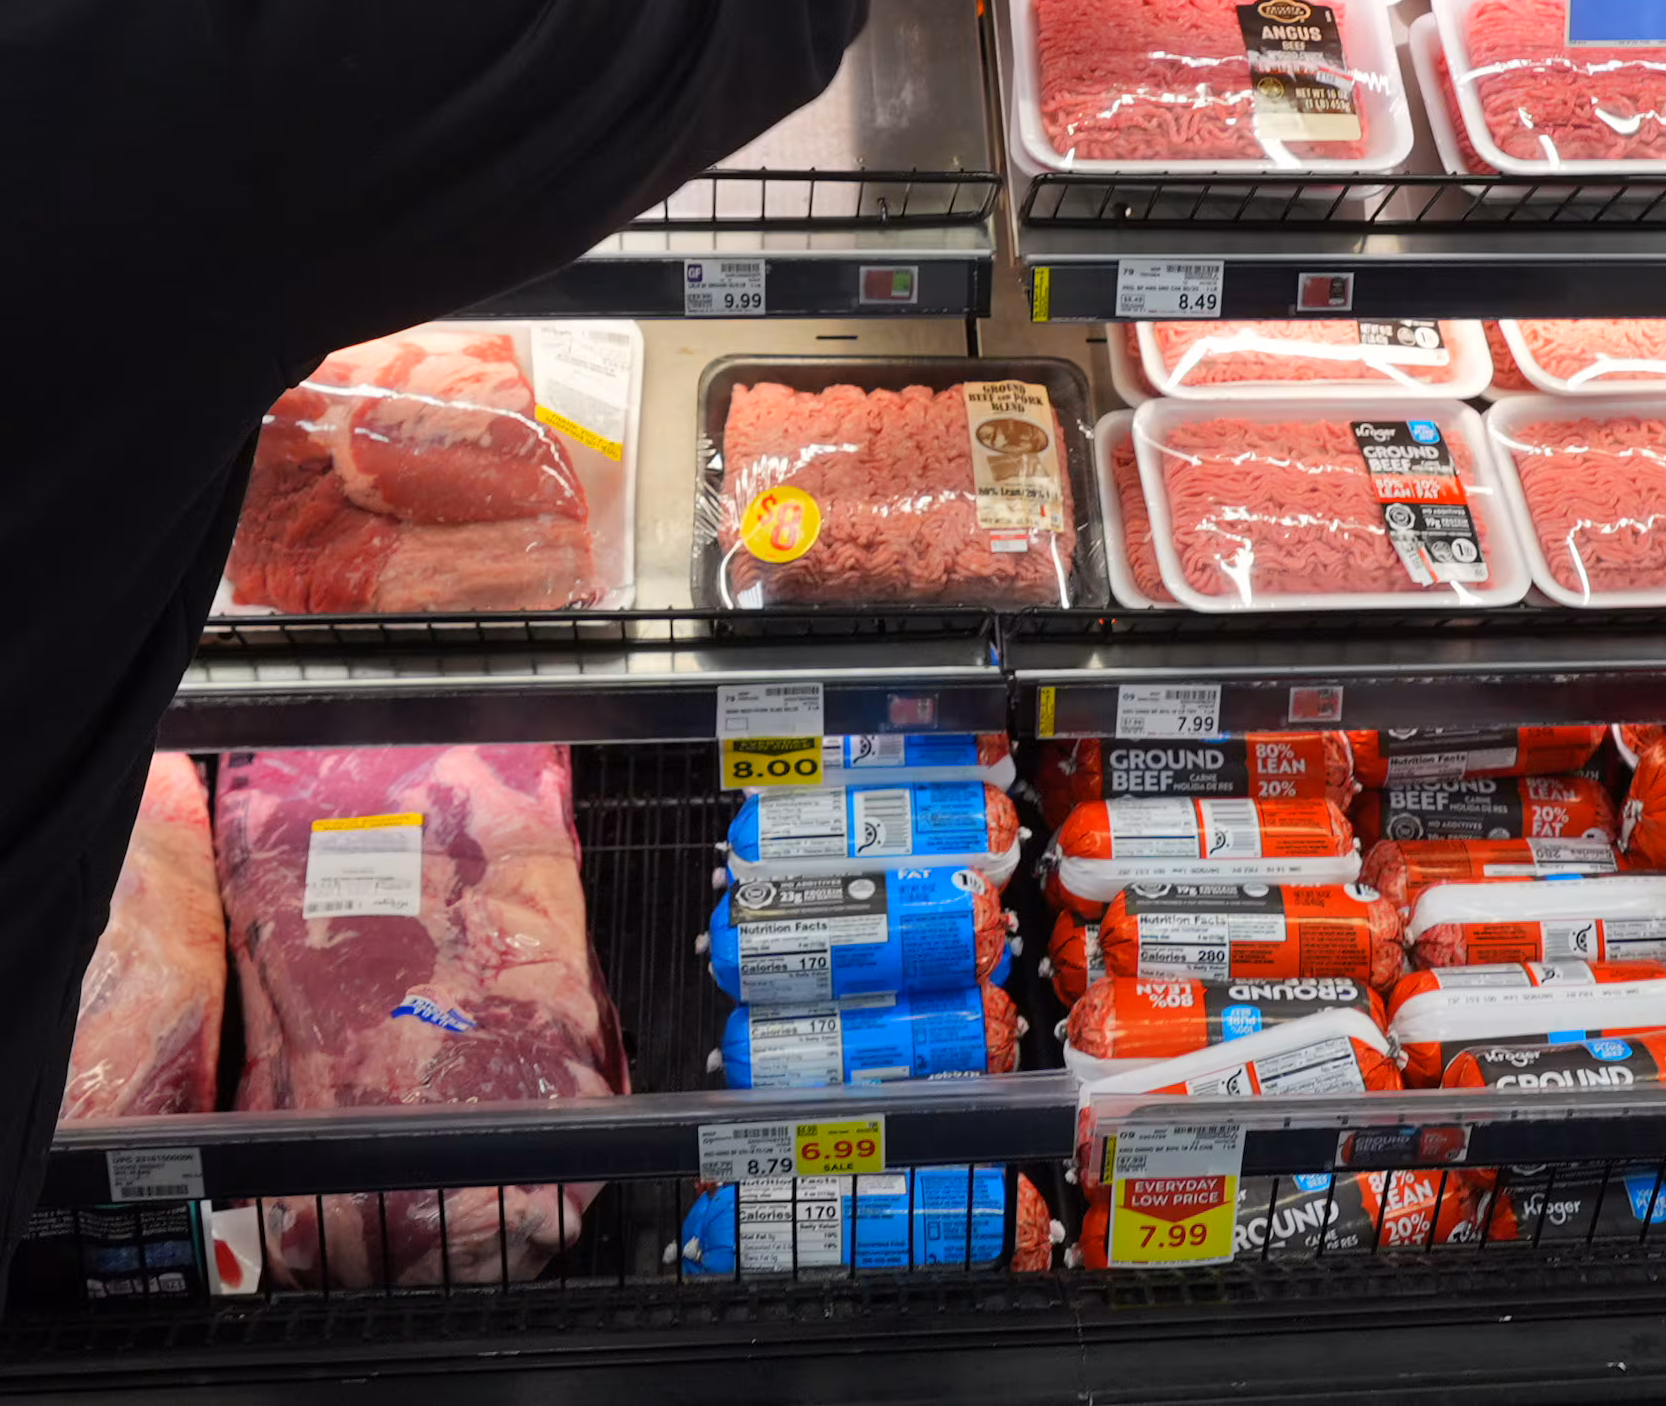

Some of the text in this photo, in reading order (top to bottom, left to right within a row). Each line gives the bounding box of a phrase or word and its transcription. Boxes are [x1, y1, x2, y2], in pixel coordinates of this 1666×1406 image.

[1260, 24, 1322, 42] ANGUS
[687, 265, 703, 279] GF
[724, 292, 762, 308] 9.99
[1178, 294, 1217, 310] 8.49
[1363, 445, 1438, 460] GROUND
[1368, 458, 1412, 473] BEEF
[1376, 486, 1439, 500] LEAN FAT
[1177, 716, 1214, 732] 7.99
[1254, 742, 1295, 759] 80%
[1109, 748, 1224, 770] GROUND
[1257, 758, 1306, 774] LEAN
[732, 758, 817, 778] 8.00
[1111, 772, 1173, 793] BEEF
[1257, 781, 1297, 797] 20%
[1389, 792, 1449, 811] BEEF
[1531, 806, 1569, 822] 20%
[1532, 821, 1561, 837] FAT
[739, 921, 827, 935] Nutrition Facts
[799, 957, 827, 970] 170
[1197, 950, 1225, 962] 280
[1228, 983, 1359, 1001] GROUND
[809, 1019, 836, 1032] 170
[800, 1139, 877, 1161] 6.99
[747, 1157, 794, 1176] 8.79
[823, 1162, 854, 1172] SALE
[1134, 1177, 1218, 1194] EVERYDAY
[1131, 1191, 1219, 1208] LOW PRICE
[804, 1205, 836, 1220] 170
[1384, 1211, 1431, 1237] 20%
[1138, 1223, 1208, 1249] 7.99
